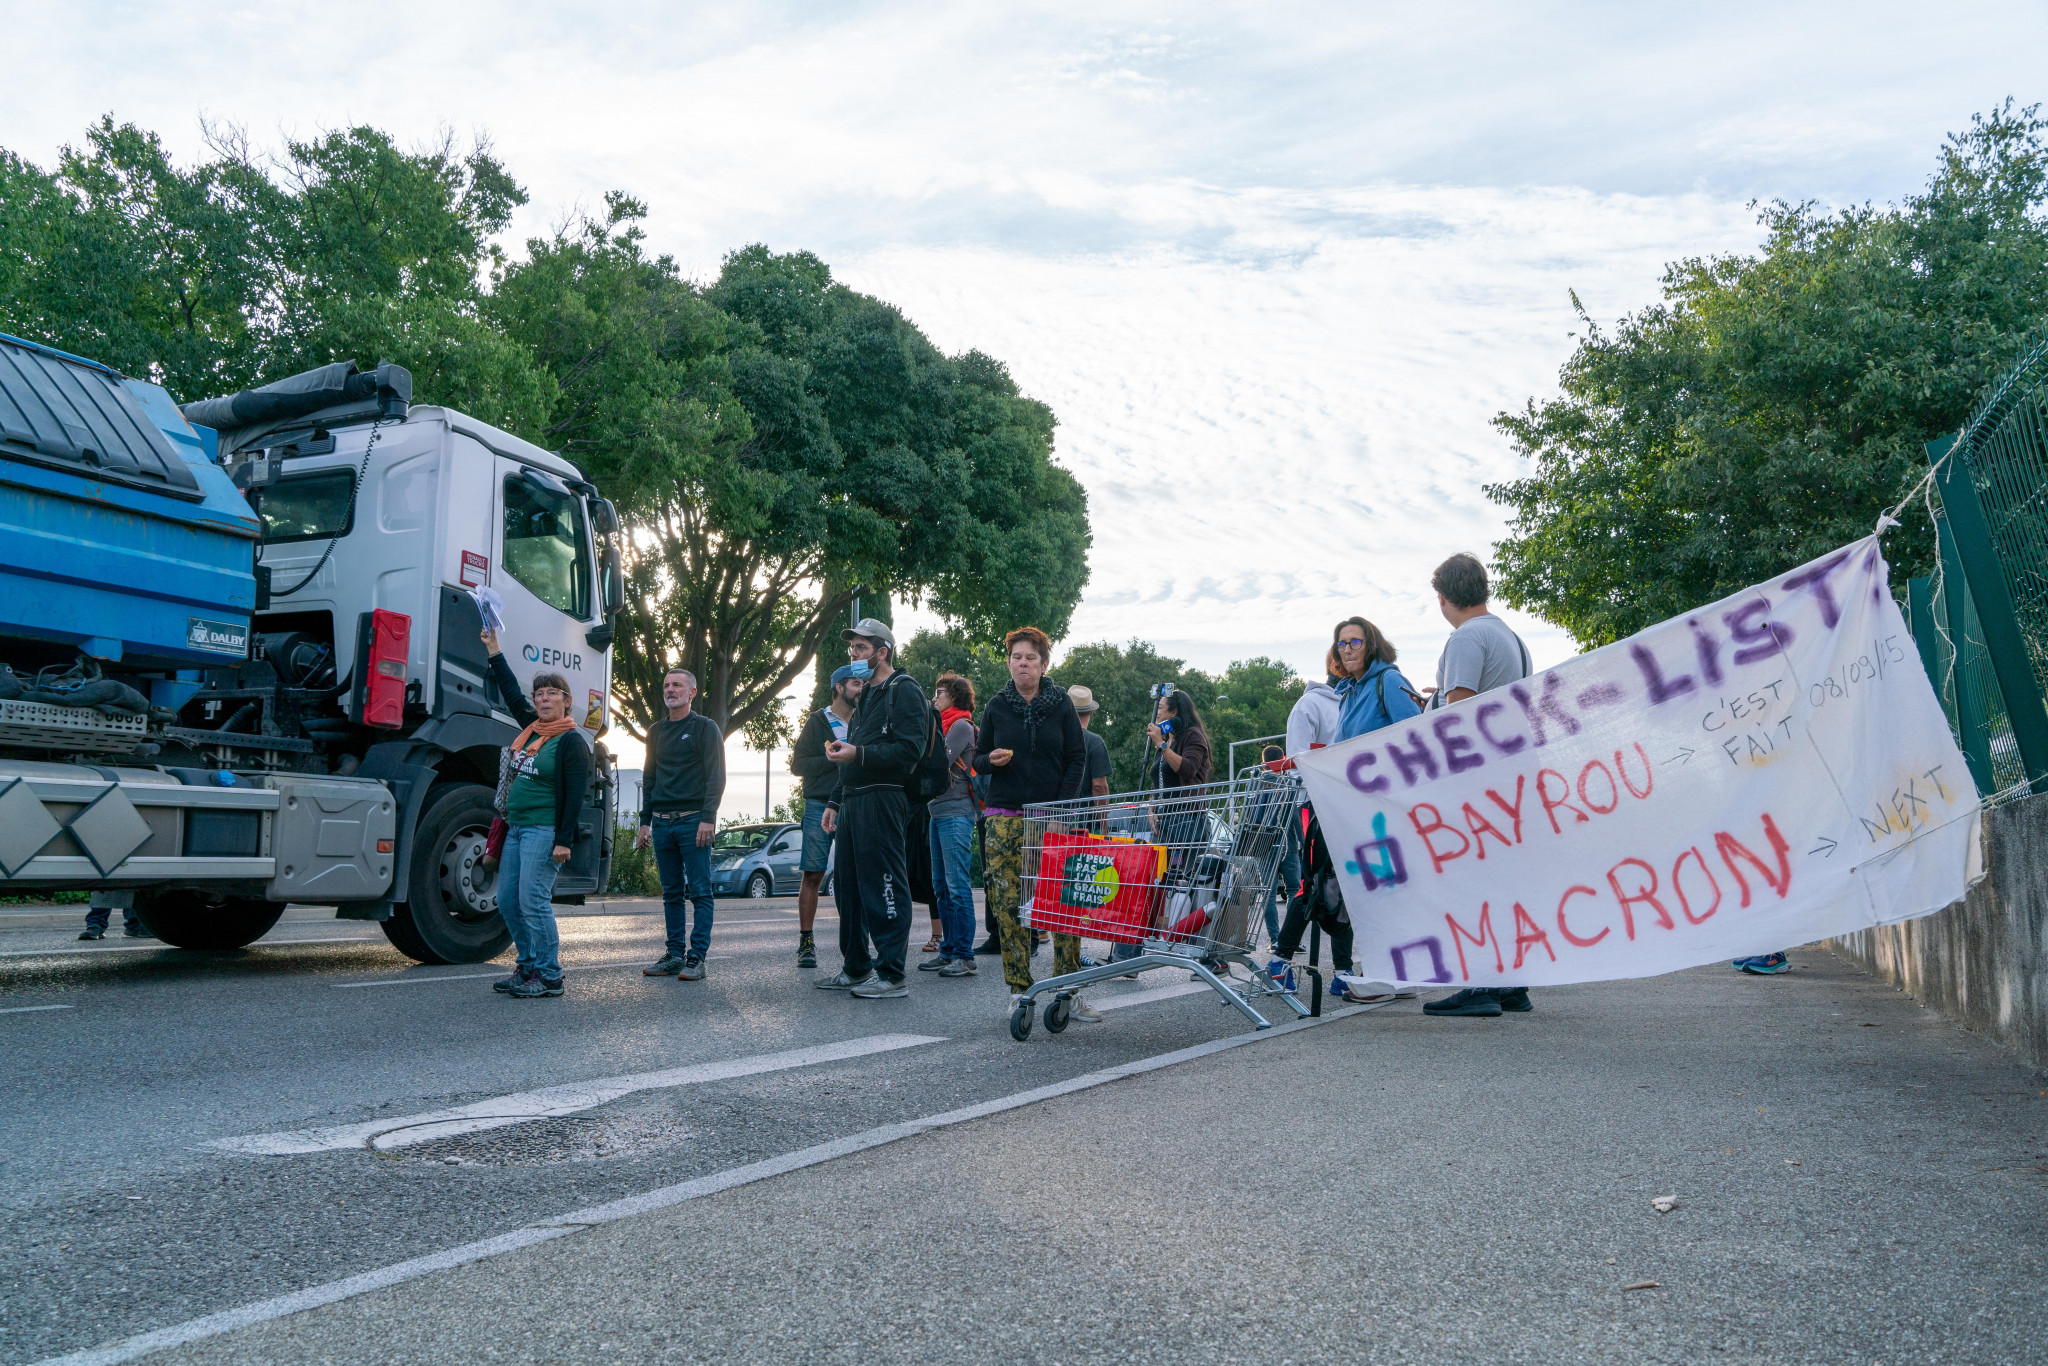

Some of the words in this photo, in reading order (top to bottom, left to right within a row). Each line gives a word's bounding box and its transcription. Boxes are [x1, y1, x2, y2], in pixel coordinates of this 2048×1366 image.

[211, 632, 245, 646] DALBY
[542, 647, 582, 671] EPUR
[1809, 635, 1905, 708] 08/09/5
[1702, 680, 1783, 732] C'EST
[1406, 743, 1654, 873] BAYROU
[1859, 765, 1943, 843] NEXT
[1074, 873, 1095, 882] J'AI
[1077, 853, 1115, 866] J'PEUX
[1074, 883, 1112, 895] GRAND
[1445, 813, 1792, 981] MACRON
